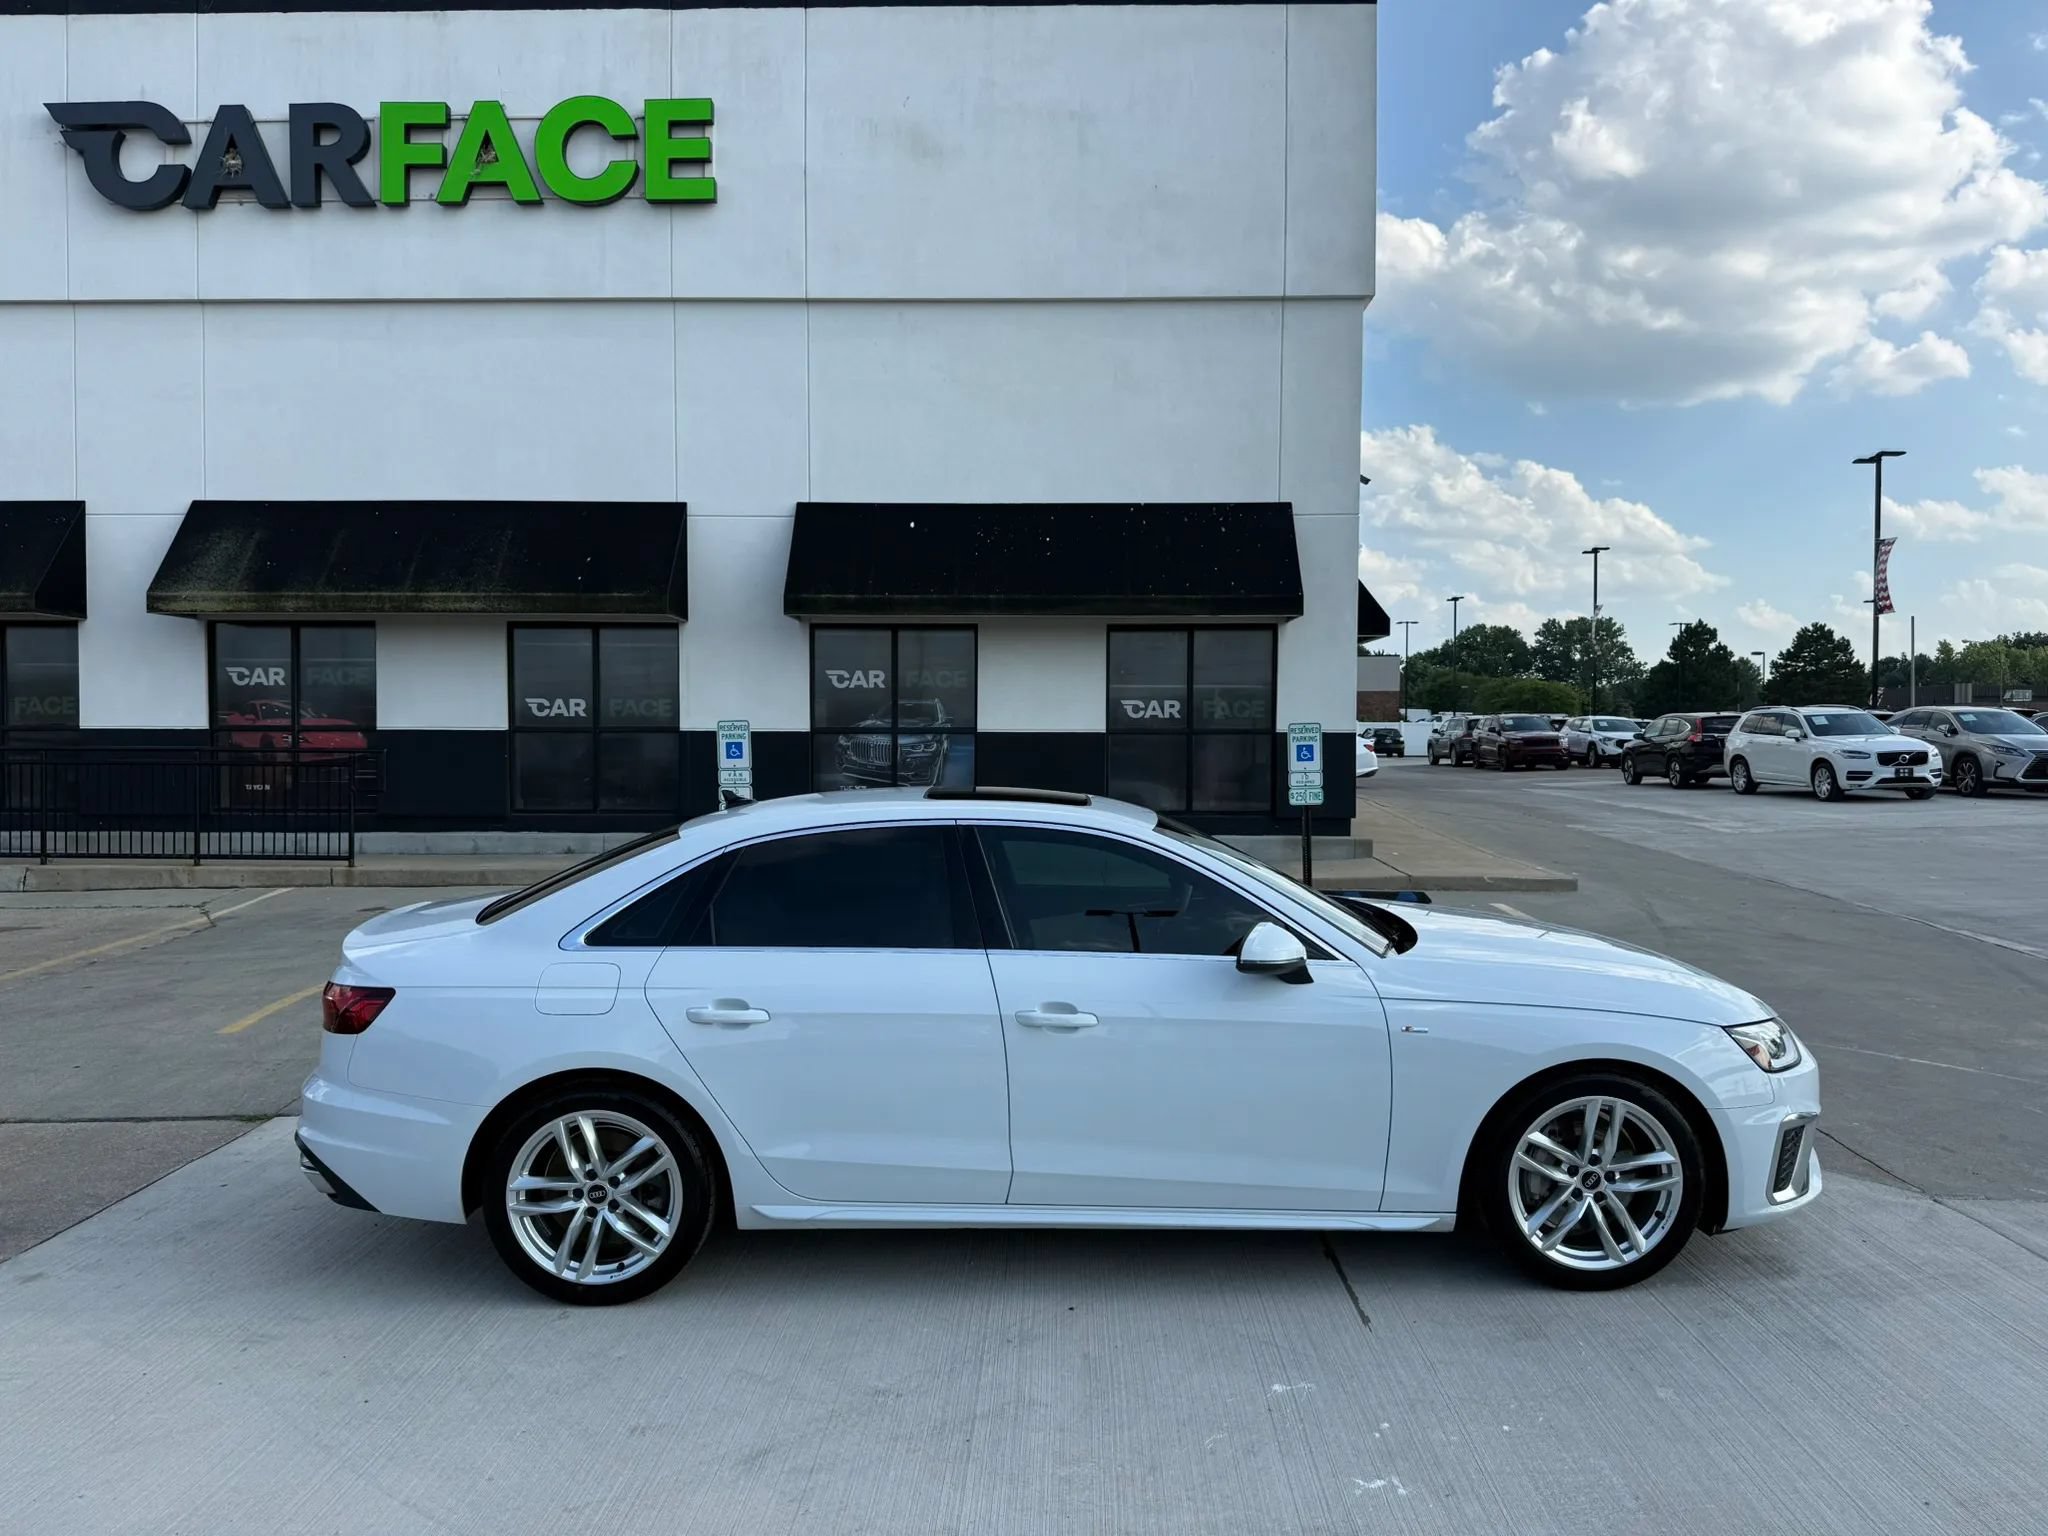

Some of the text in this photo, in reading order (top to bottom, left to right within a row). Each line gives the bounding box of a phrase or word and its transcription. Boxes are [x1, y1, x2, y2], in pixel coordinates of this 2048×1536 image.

[43, 95, 717, 211] CARFACE
[225, 666, 369, 686] CAR FACE
[825, 669, 968, 688] CAR FACE
[15, 696, 76, 715] FACE
[525, 698, 672, 717] CAR FACE
[1121, 699, 1264, 719] CAR FACE
[719, 724, 747, 732] RESERVED
[1292, 735, 1318, 743] PARKING
[1290, 791, 1322, 802] $250 FINE
